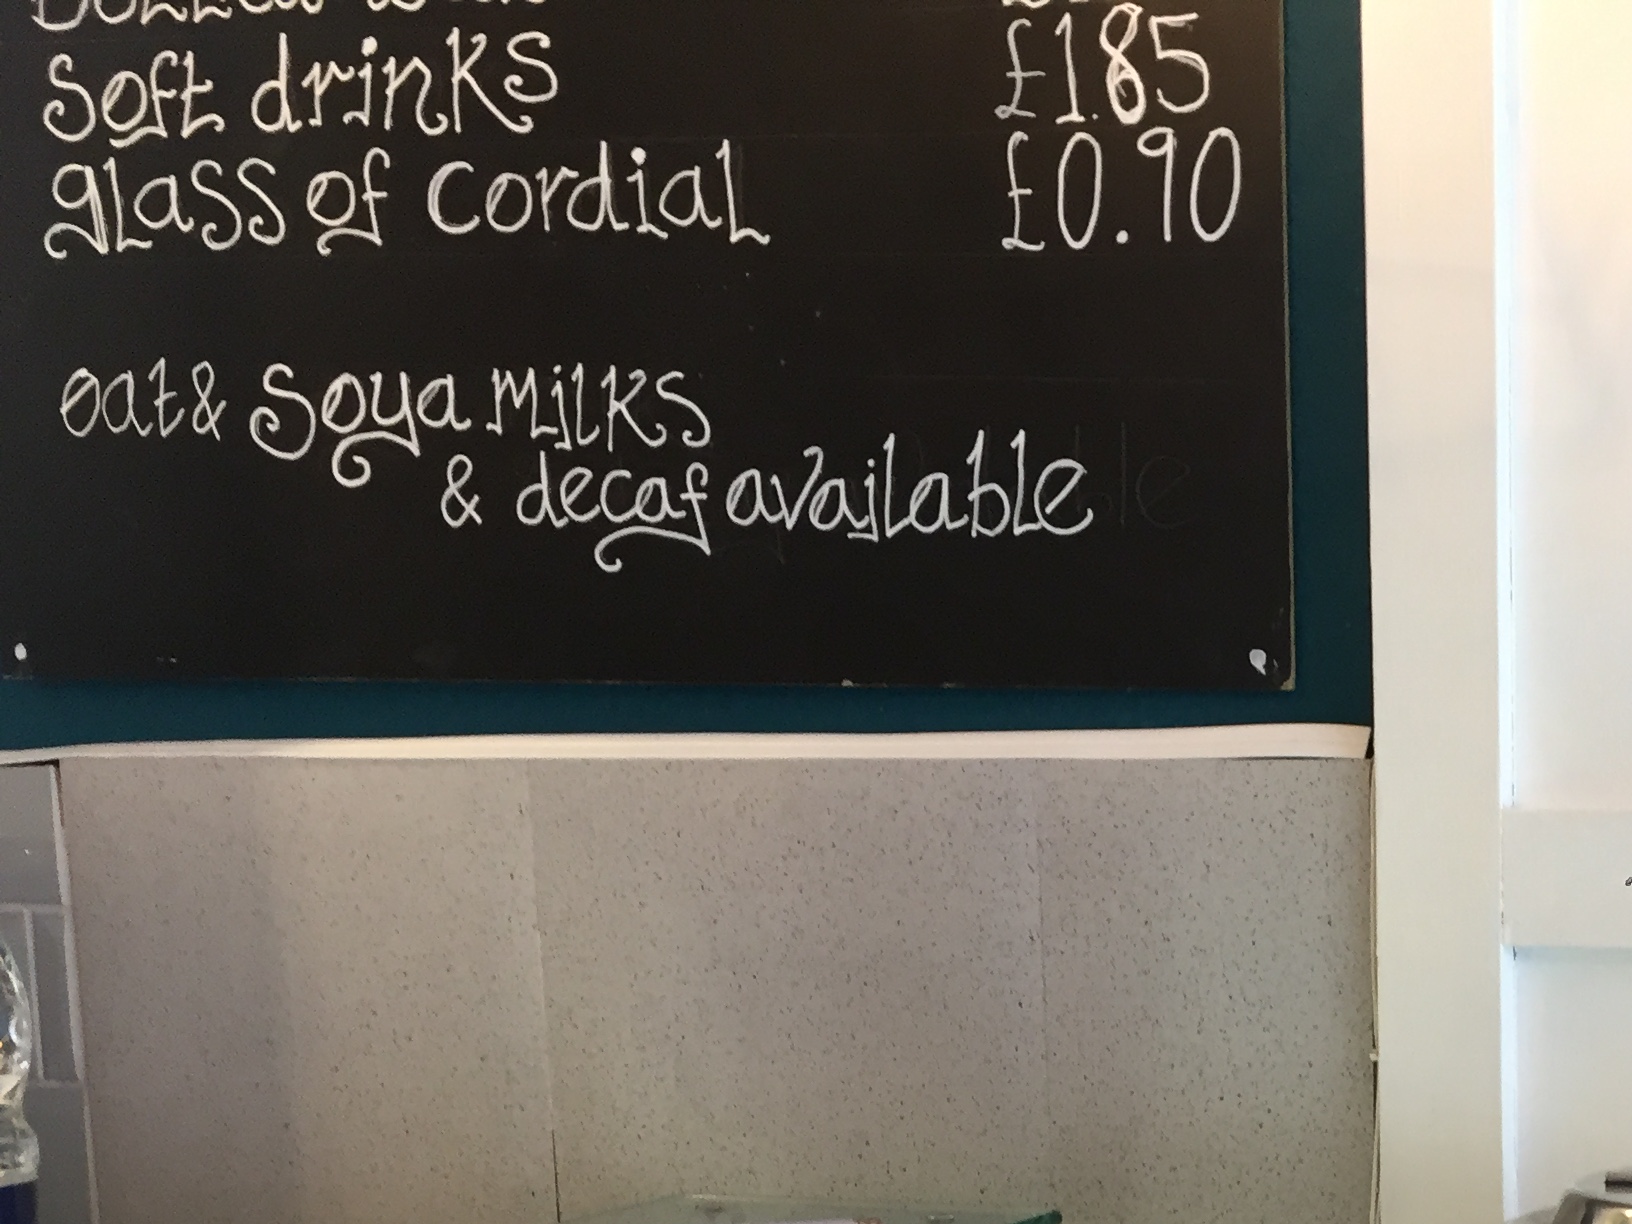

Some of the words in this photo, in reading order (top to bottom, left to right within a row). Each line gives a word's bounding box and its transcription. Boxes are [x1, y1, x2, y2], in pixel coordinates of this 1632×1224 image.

[994, 2, 1211, 125] £1.85
[305, 146, 391, 258] of
[1001, 126, 1242, 252] £0.90
[440, 453, 483, 529] &
[516, 450, 712, 573] decaf
[725, 428, 1094, 543] available
